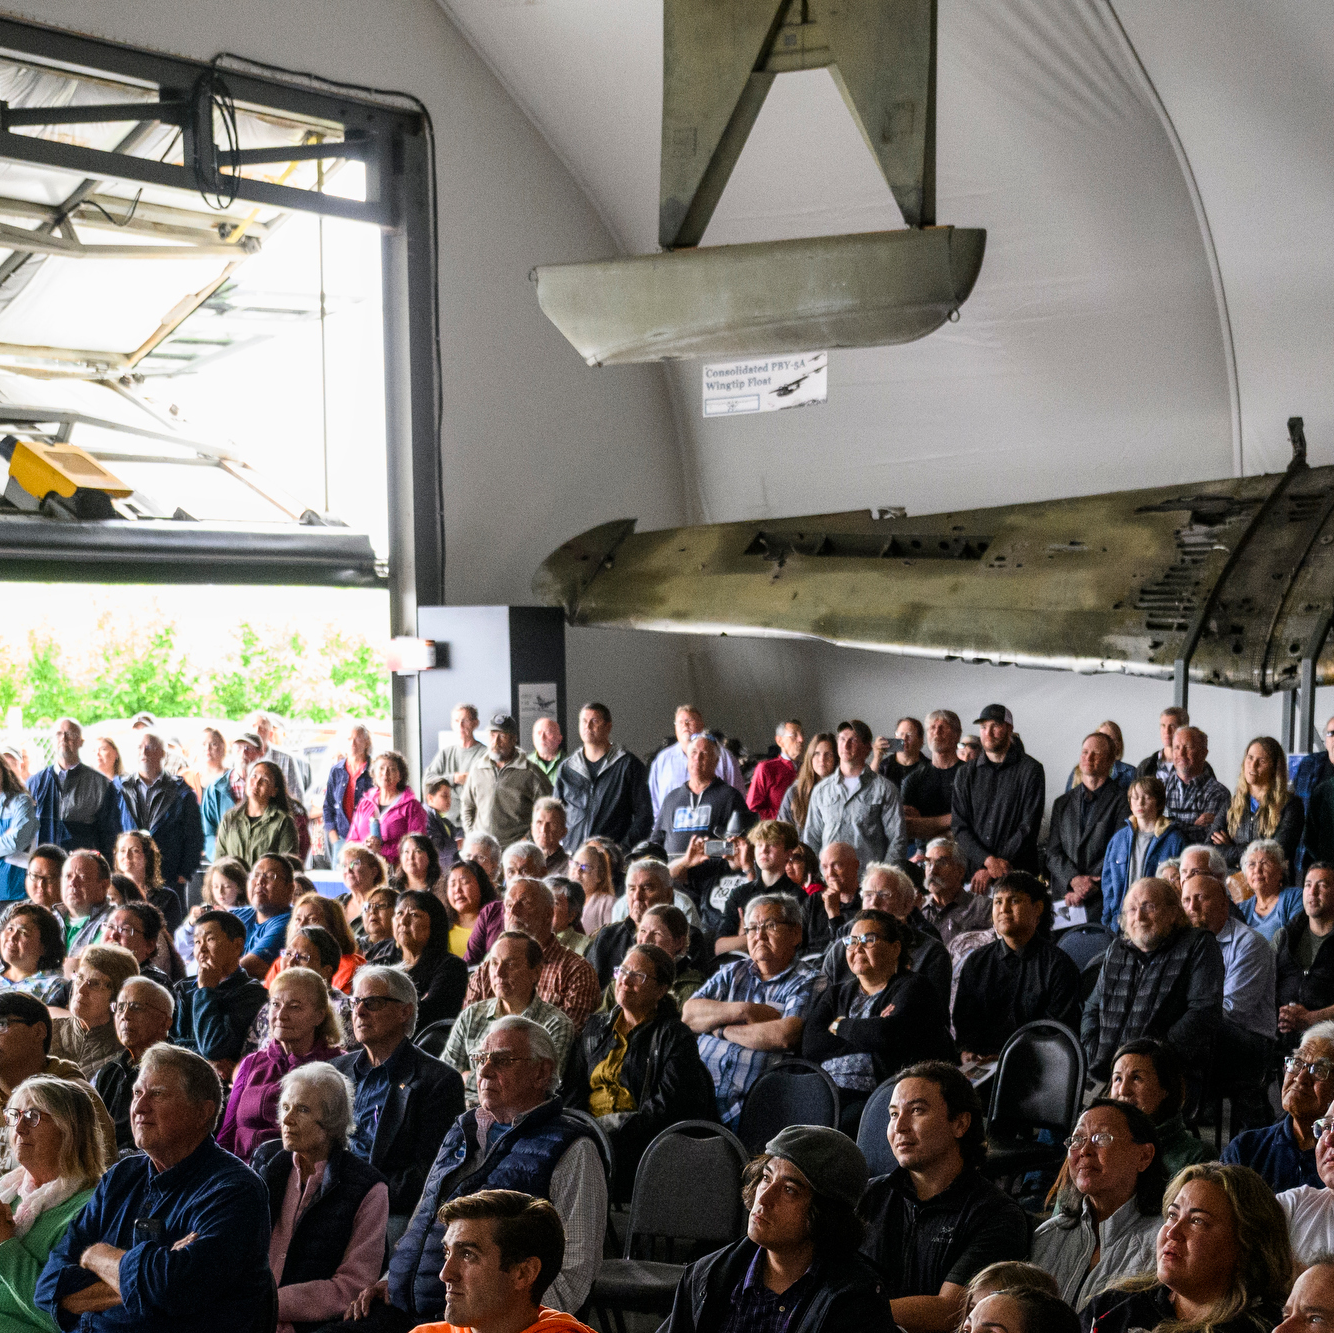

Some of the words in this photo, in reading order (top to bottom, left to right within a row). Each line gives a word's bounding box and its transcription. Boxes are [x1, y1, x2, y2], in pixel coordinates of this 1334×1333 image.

[706, 363, 769, 378] Consolidated
[771, 359, 806, 371] PBY-5A
[706, 380, 745, 391] Wingtip
[748, 377, 771, 388] Float
